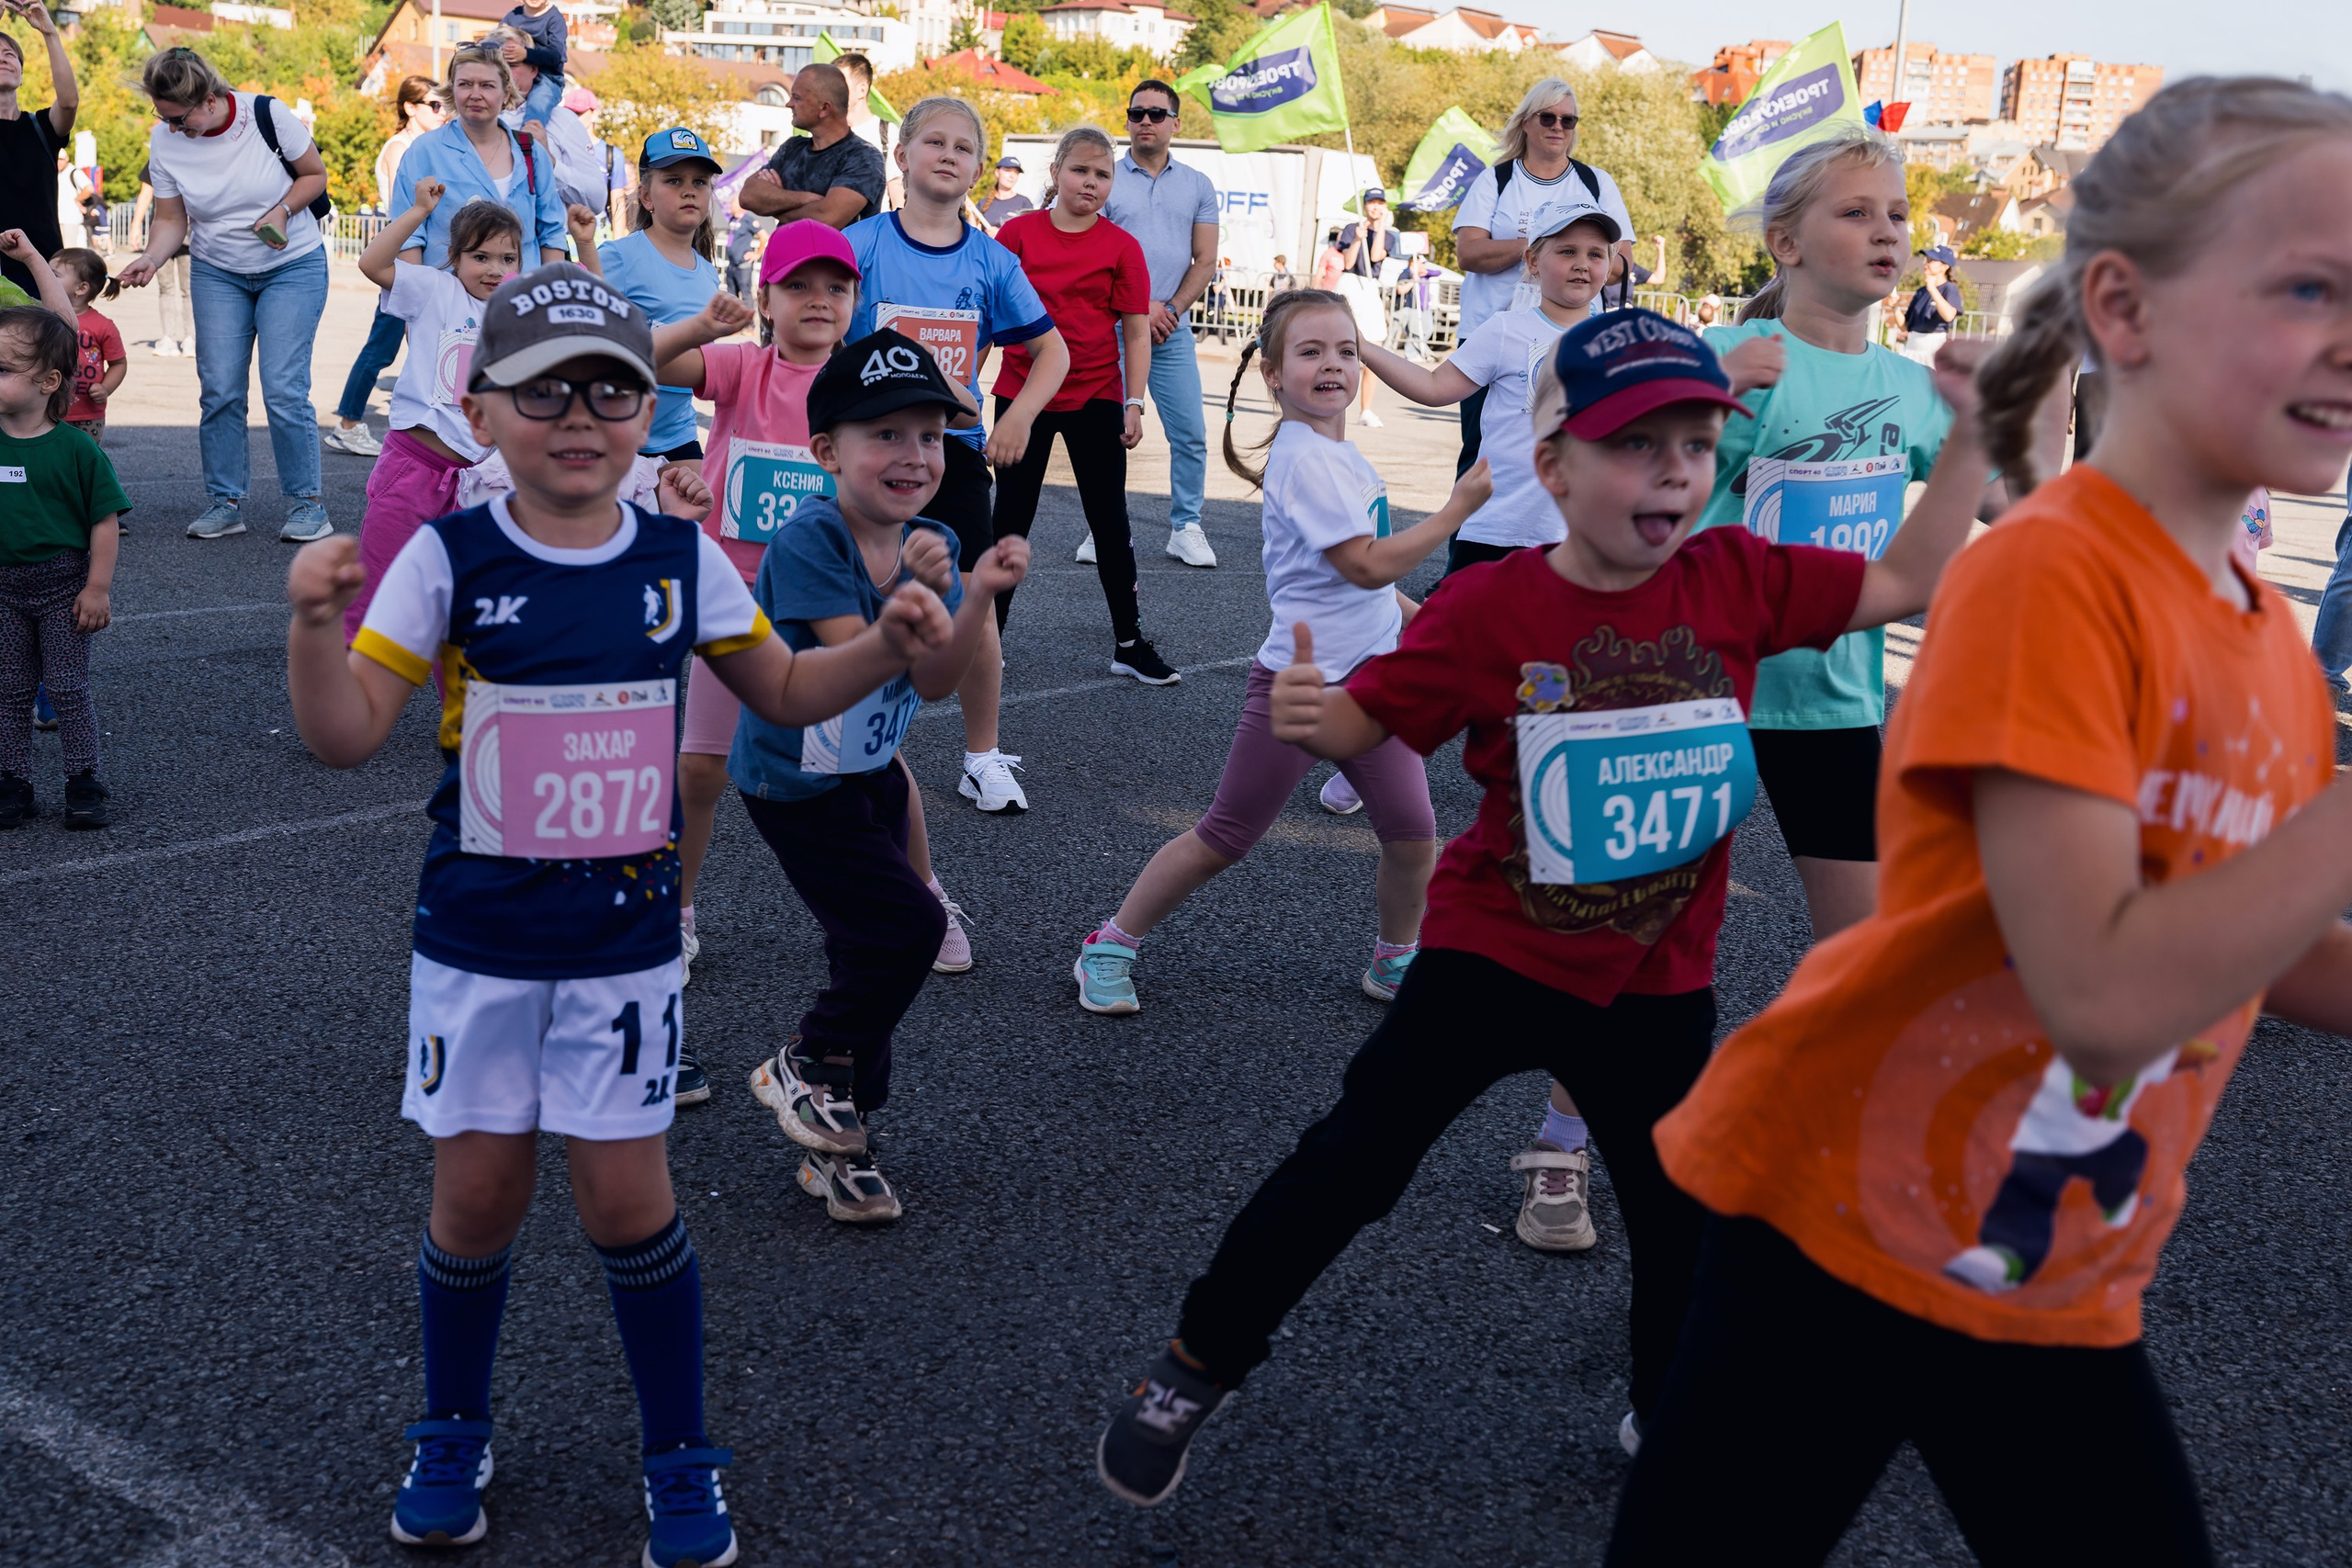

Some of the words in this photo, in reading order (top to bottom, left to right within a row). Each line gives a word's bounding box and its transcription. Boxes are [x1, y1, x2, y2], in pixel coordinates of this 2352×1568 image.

[510, 279, 630, 319] BOSTON
[558, 308, 595, 319] 1630
[920, 328, 962, 343] ВАРВАРА
[773, 470, 824, 492] КСЕНИЯ
[1829, 491, 1877, 517] МАРИЯ
[1810, 518, 1889, 561] 1892
[563, 729, 636, 761] ЗАХАР
[1598, 743, 1735, 785] АЛЕКСАНДР
[533, 766, 662, 839] 2872
[1602, 782, 1732, 860] 3471
